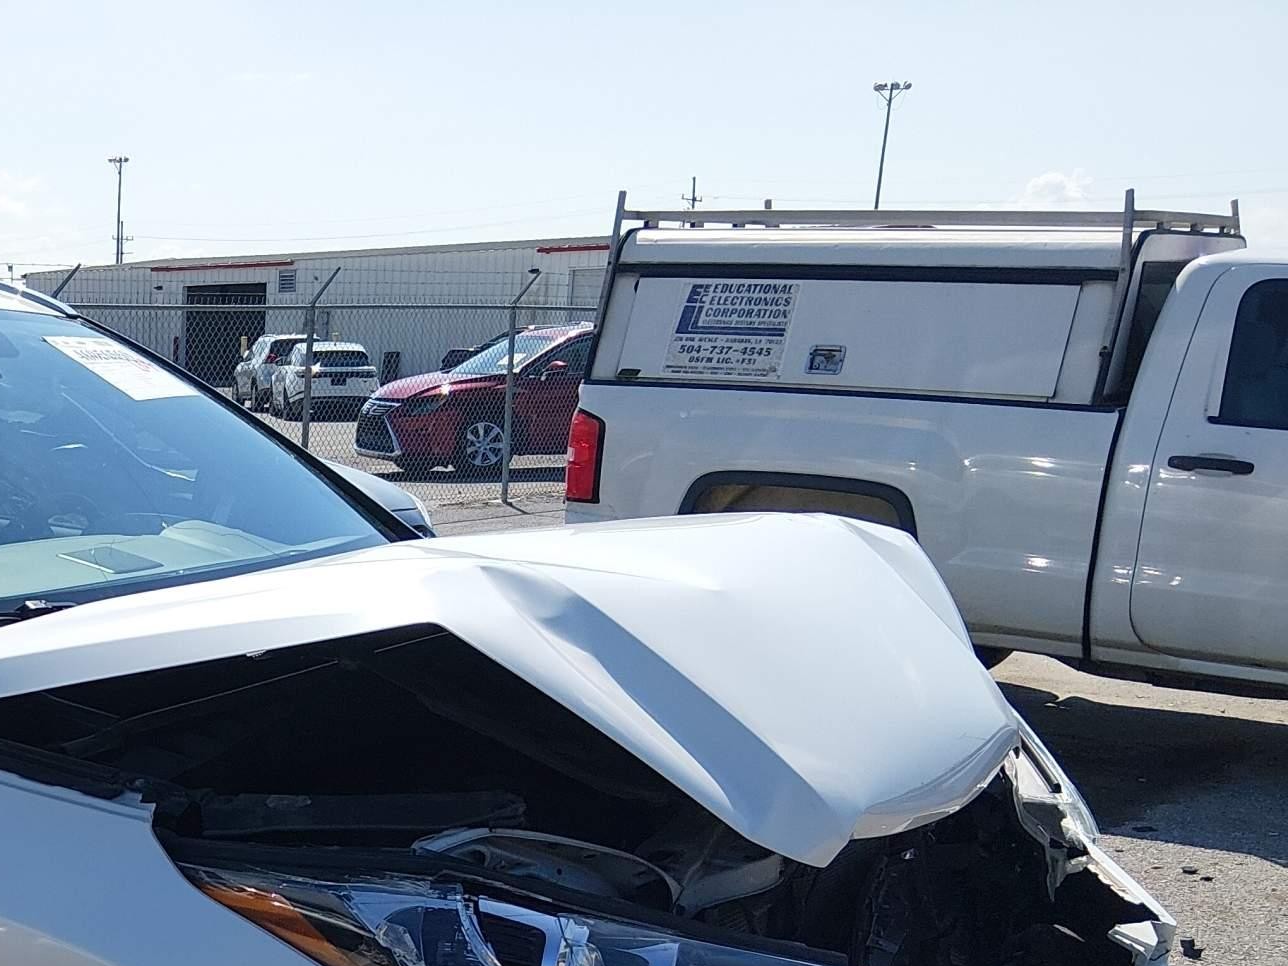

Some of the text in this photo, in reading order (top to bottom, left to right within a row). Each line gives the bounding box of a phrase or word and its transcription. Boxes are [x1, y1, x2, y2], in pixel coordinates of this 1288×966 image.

[712, 283, 794, 295] EDUCATIONAL
[709, 295, 792, 307] ELECTRONICS
[705, 307, 791, 319] CORPORATION
[678, 345, 773, 357] 504-737-4545
